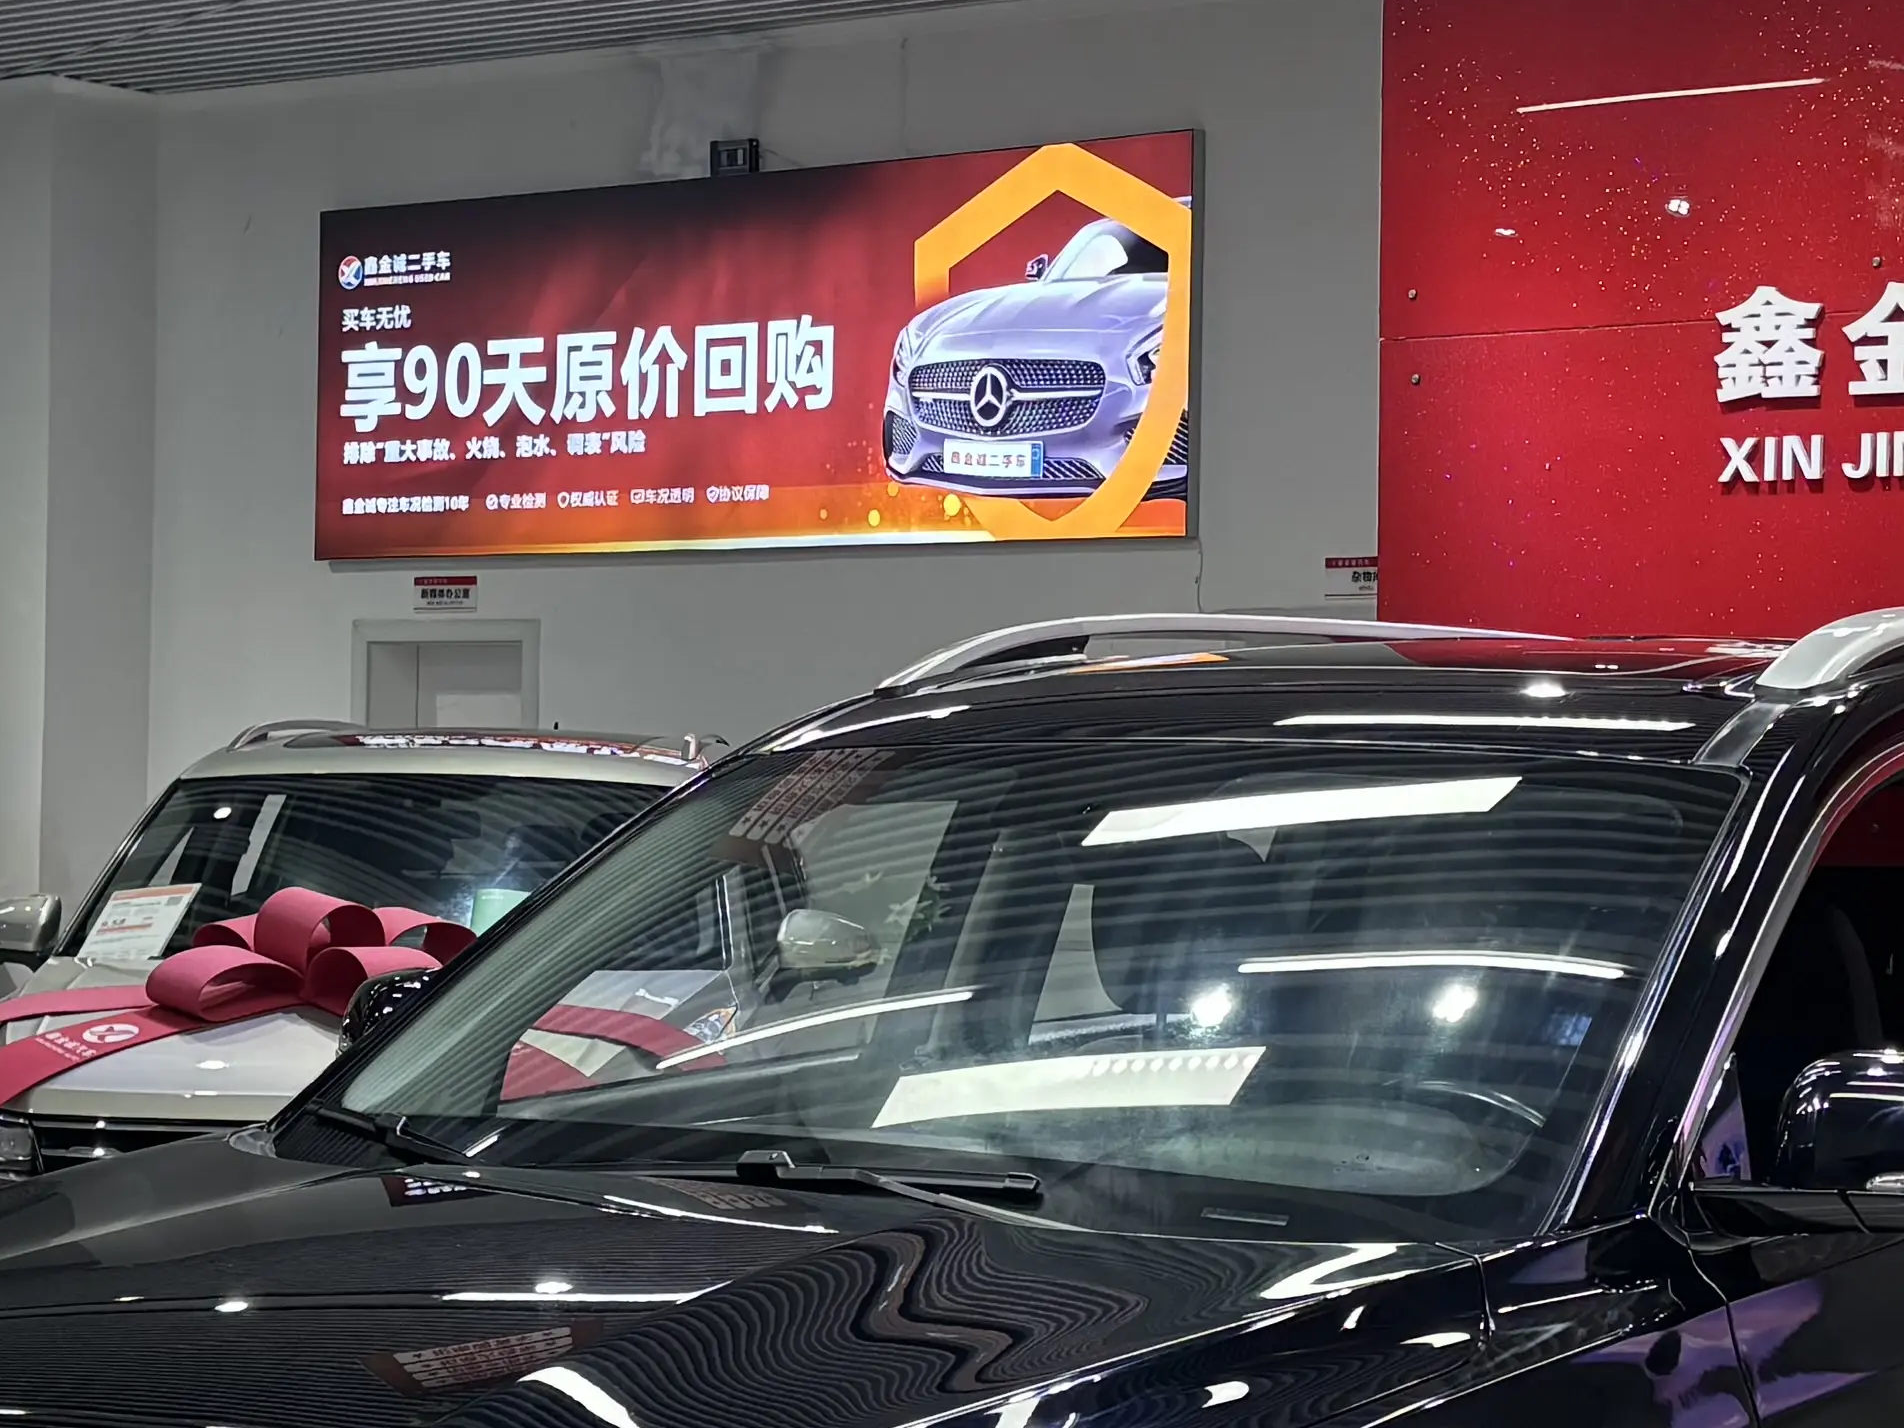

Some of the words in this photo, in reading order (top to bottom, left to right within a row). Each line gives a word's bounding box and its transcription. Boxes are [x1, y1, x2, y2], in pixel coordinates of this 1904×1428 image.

[341, 304, 412, 332] 买车无忧
[339, 314, 835, 433] 享90天原价回购
[1717, 432, 1824, 484] XIN
